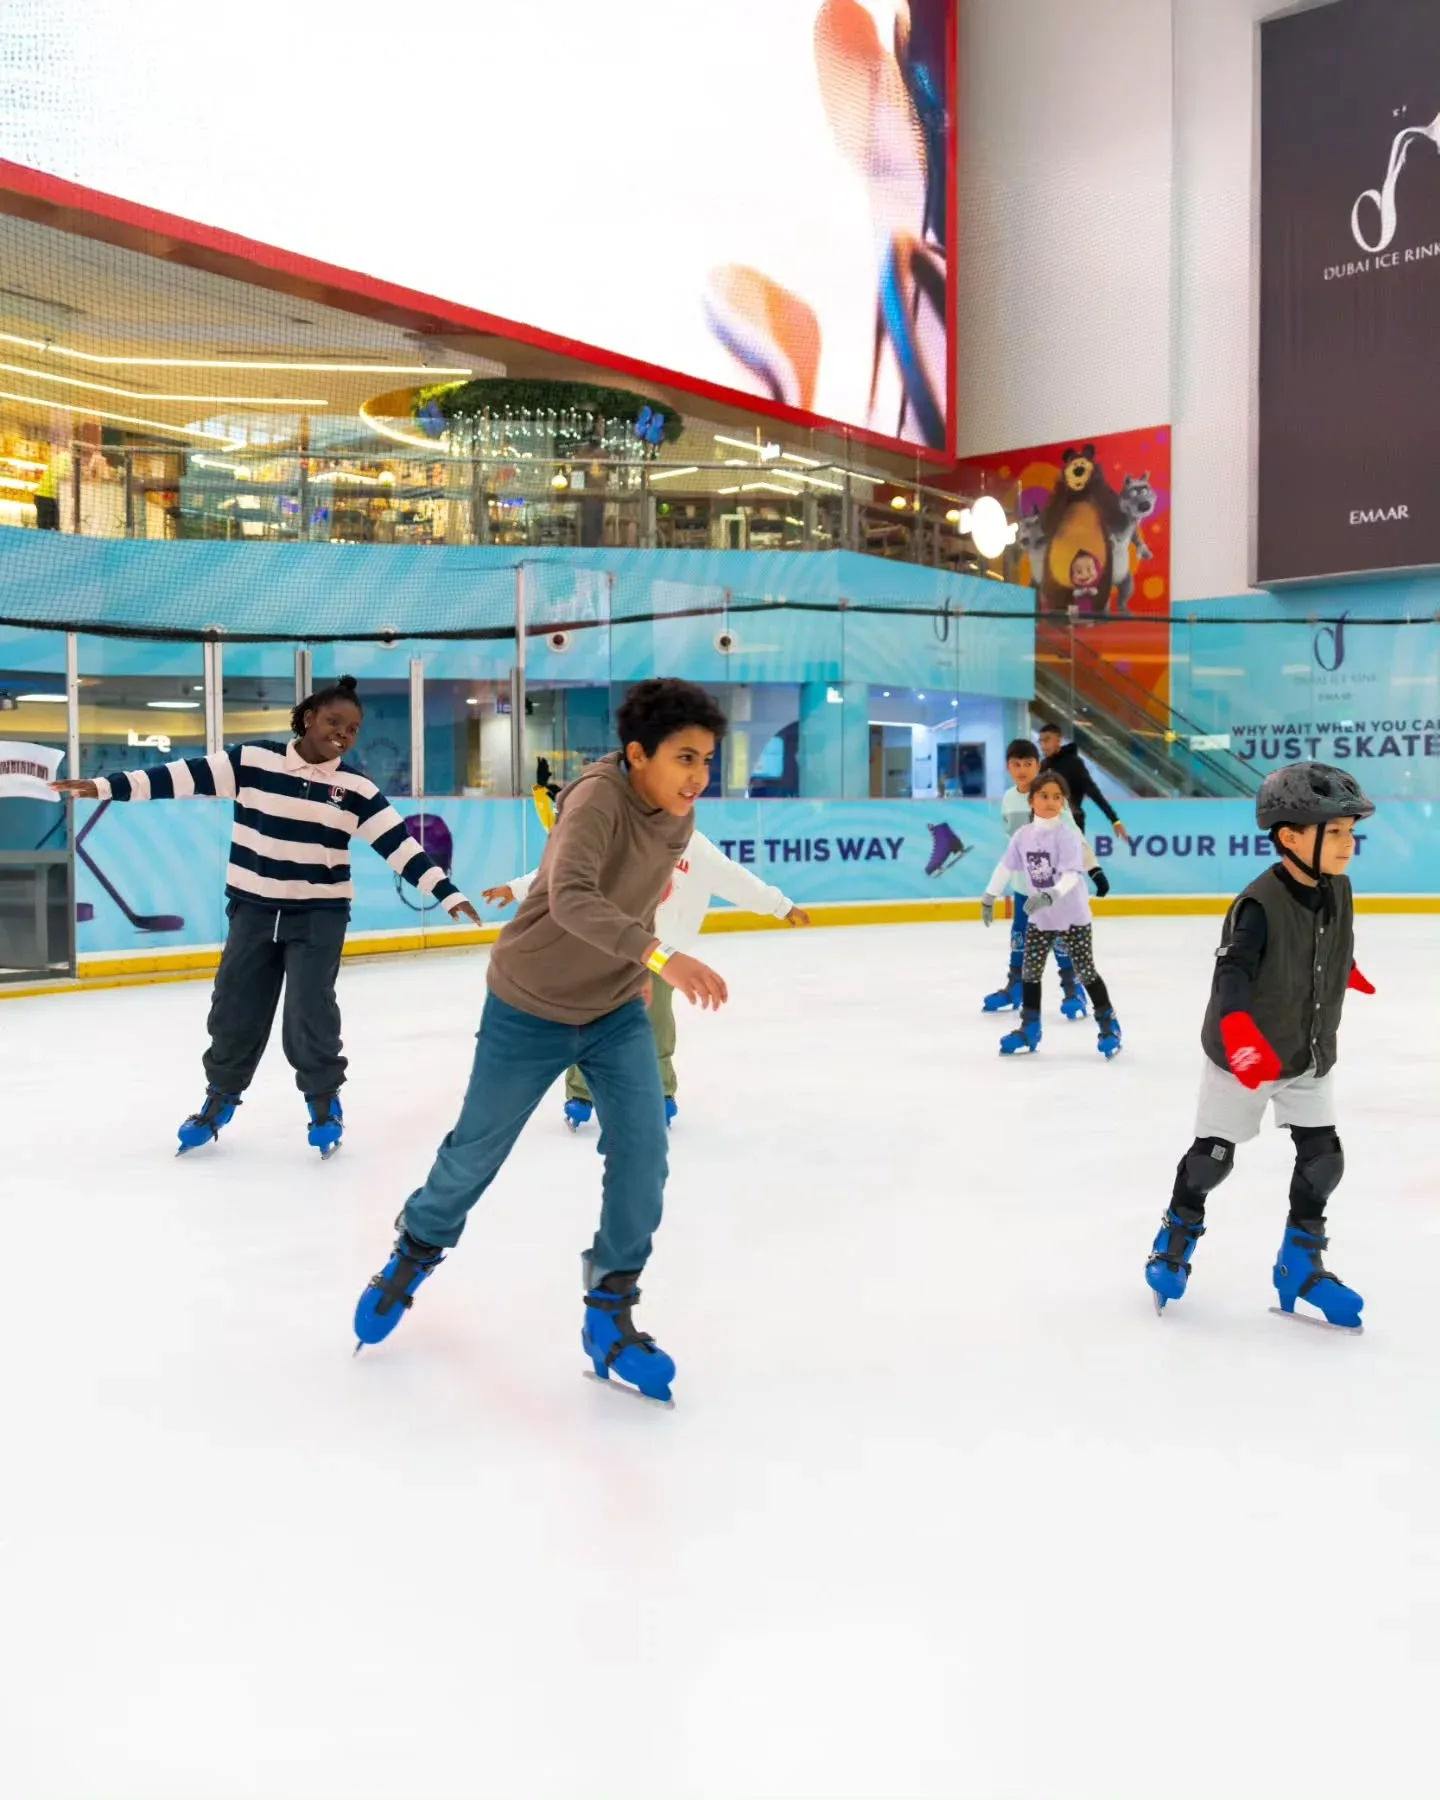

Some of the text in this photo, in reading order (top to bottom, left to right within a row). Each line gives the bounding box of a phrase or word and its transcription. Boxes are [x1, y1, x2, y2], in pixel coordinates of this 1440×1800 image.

[1323, 258, 1370, 281] DUBAI
[1375, 252, 1401, 269] ICE
[1349, 504, 1409, 525] EMAAR
[1232, 719, 1440, 737] WHY WAIT WHEN YOU CA
[1238, 734, 1440, 760] JUST SKATE
[764, 838, 831, 863] THIS
[837, 837, 905, 861] WAY
[1126, 834, 1216, 857] YOUR
